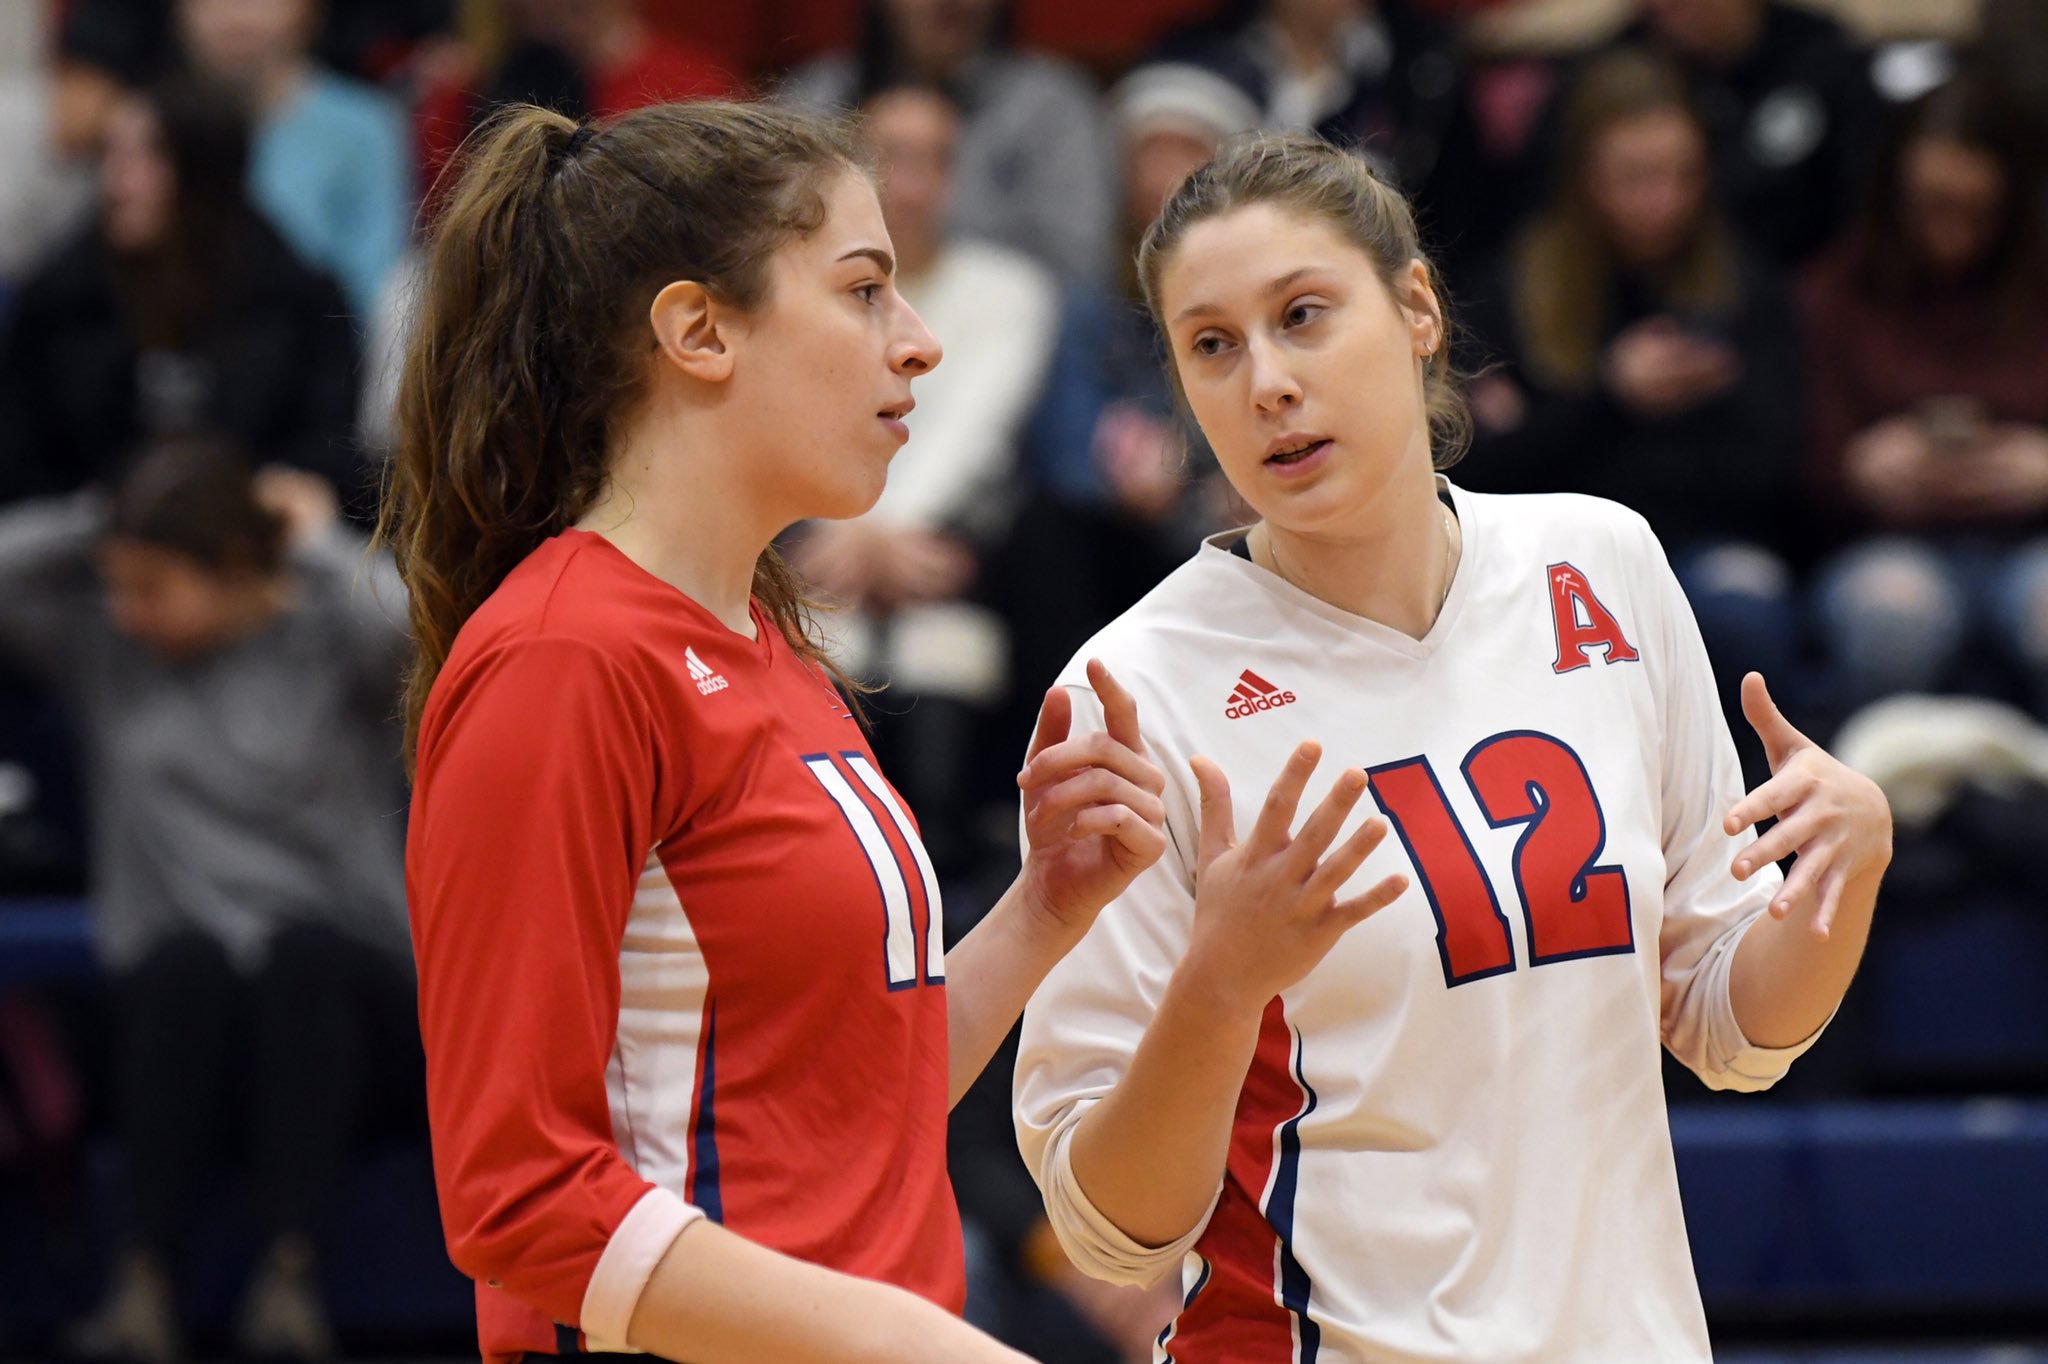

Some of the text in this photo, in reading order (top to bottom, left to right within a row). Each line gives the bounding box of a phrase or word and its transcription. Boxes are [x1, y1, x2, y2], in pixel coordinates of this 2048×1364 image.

[1225, 690, 1297, 720] adidas
[1547, 561, 1639, 674] A
[800, 750, 946, 993] 11
[1364, 729, 1636, 989] 12
